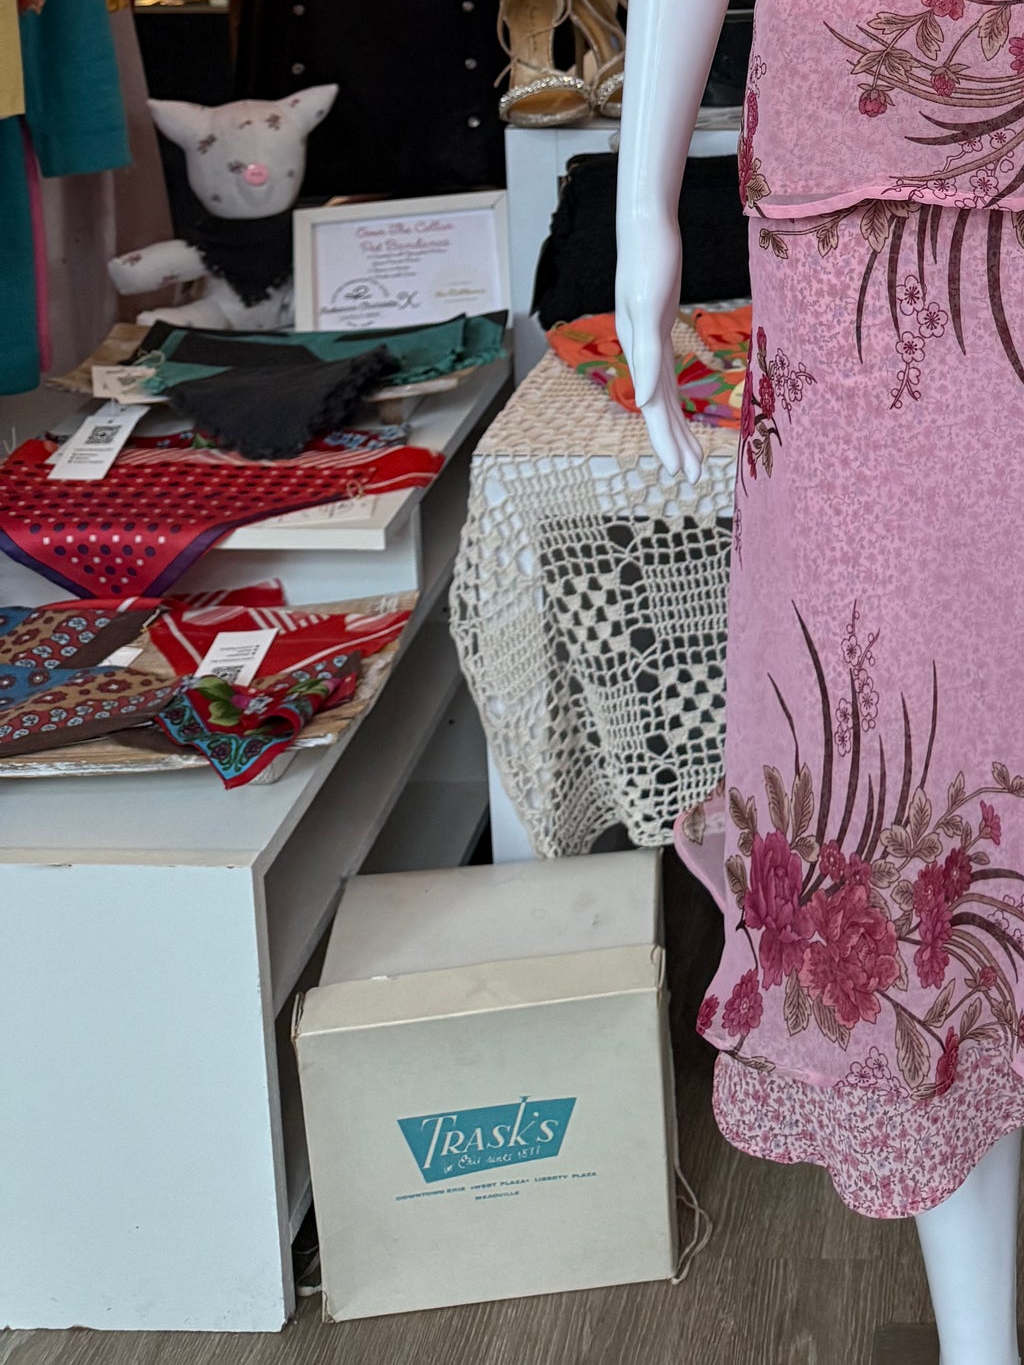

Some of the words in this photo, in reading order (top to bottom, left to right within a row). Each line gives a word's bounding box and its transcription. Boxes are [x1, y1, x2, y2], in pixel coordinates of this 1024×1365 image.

[395, 1189, 446, 1201] DOWNTOWN
[534, 1174, 568, 1183] LIBERTY
[571, 1171, 597, 1179] PLAZA
[475, 1190, 520, 1201] MEADVILLE
